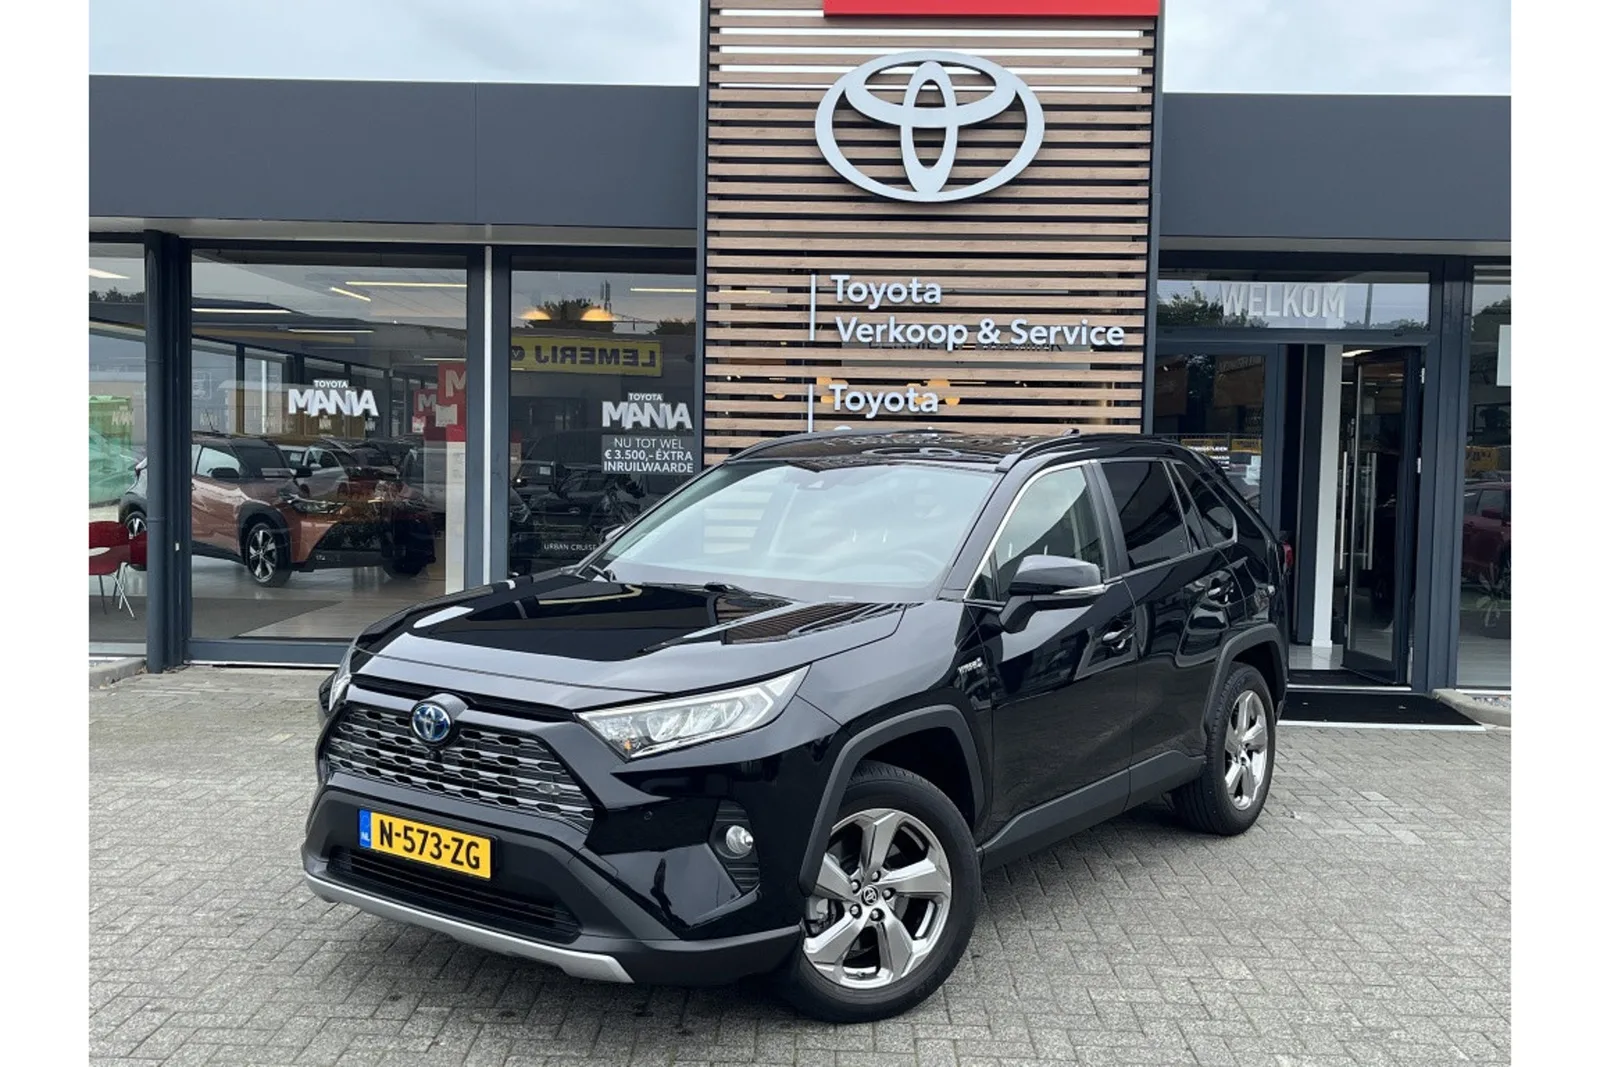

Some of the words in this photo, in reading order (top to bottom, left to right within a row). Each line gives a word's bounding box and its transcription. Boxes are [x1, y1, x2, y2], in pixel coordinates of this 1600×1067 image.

[830, 274, 942, 309] Toyota
[1220, 283, 1346, 318] WELKOM
[835, 316, 968, 351] Verkoop
[976, 318, 1001, 344] &
[1010, 318, 1125, 346] Service
[313, 380, 348, 389] TOYOTA
[288, 388, 380, 418] MANIA
[627, 393, 663, 401] TOYOTA
[828, 384, 939, 419] Toyota
[602, 401, 693, 430] MANIA
[614, 437, 632, 449] NU
[636, 438, 657, 449] TOT
[604, 449, 612, 460] €
[604, 461, 694, 473] INRUILWAARDE
[570, 543, 599, 551] CRUISE
[360, 832, 370, 842] NL
[379, 819, 481, 870] N-573-ZG
